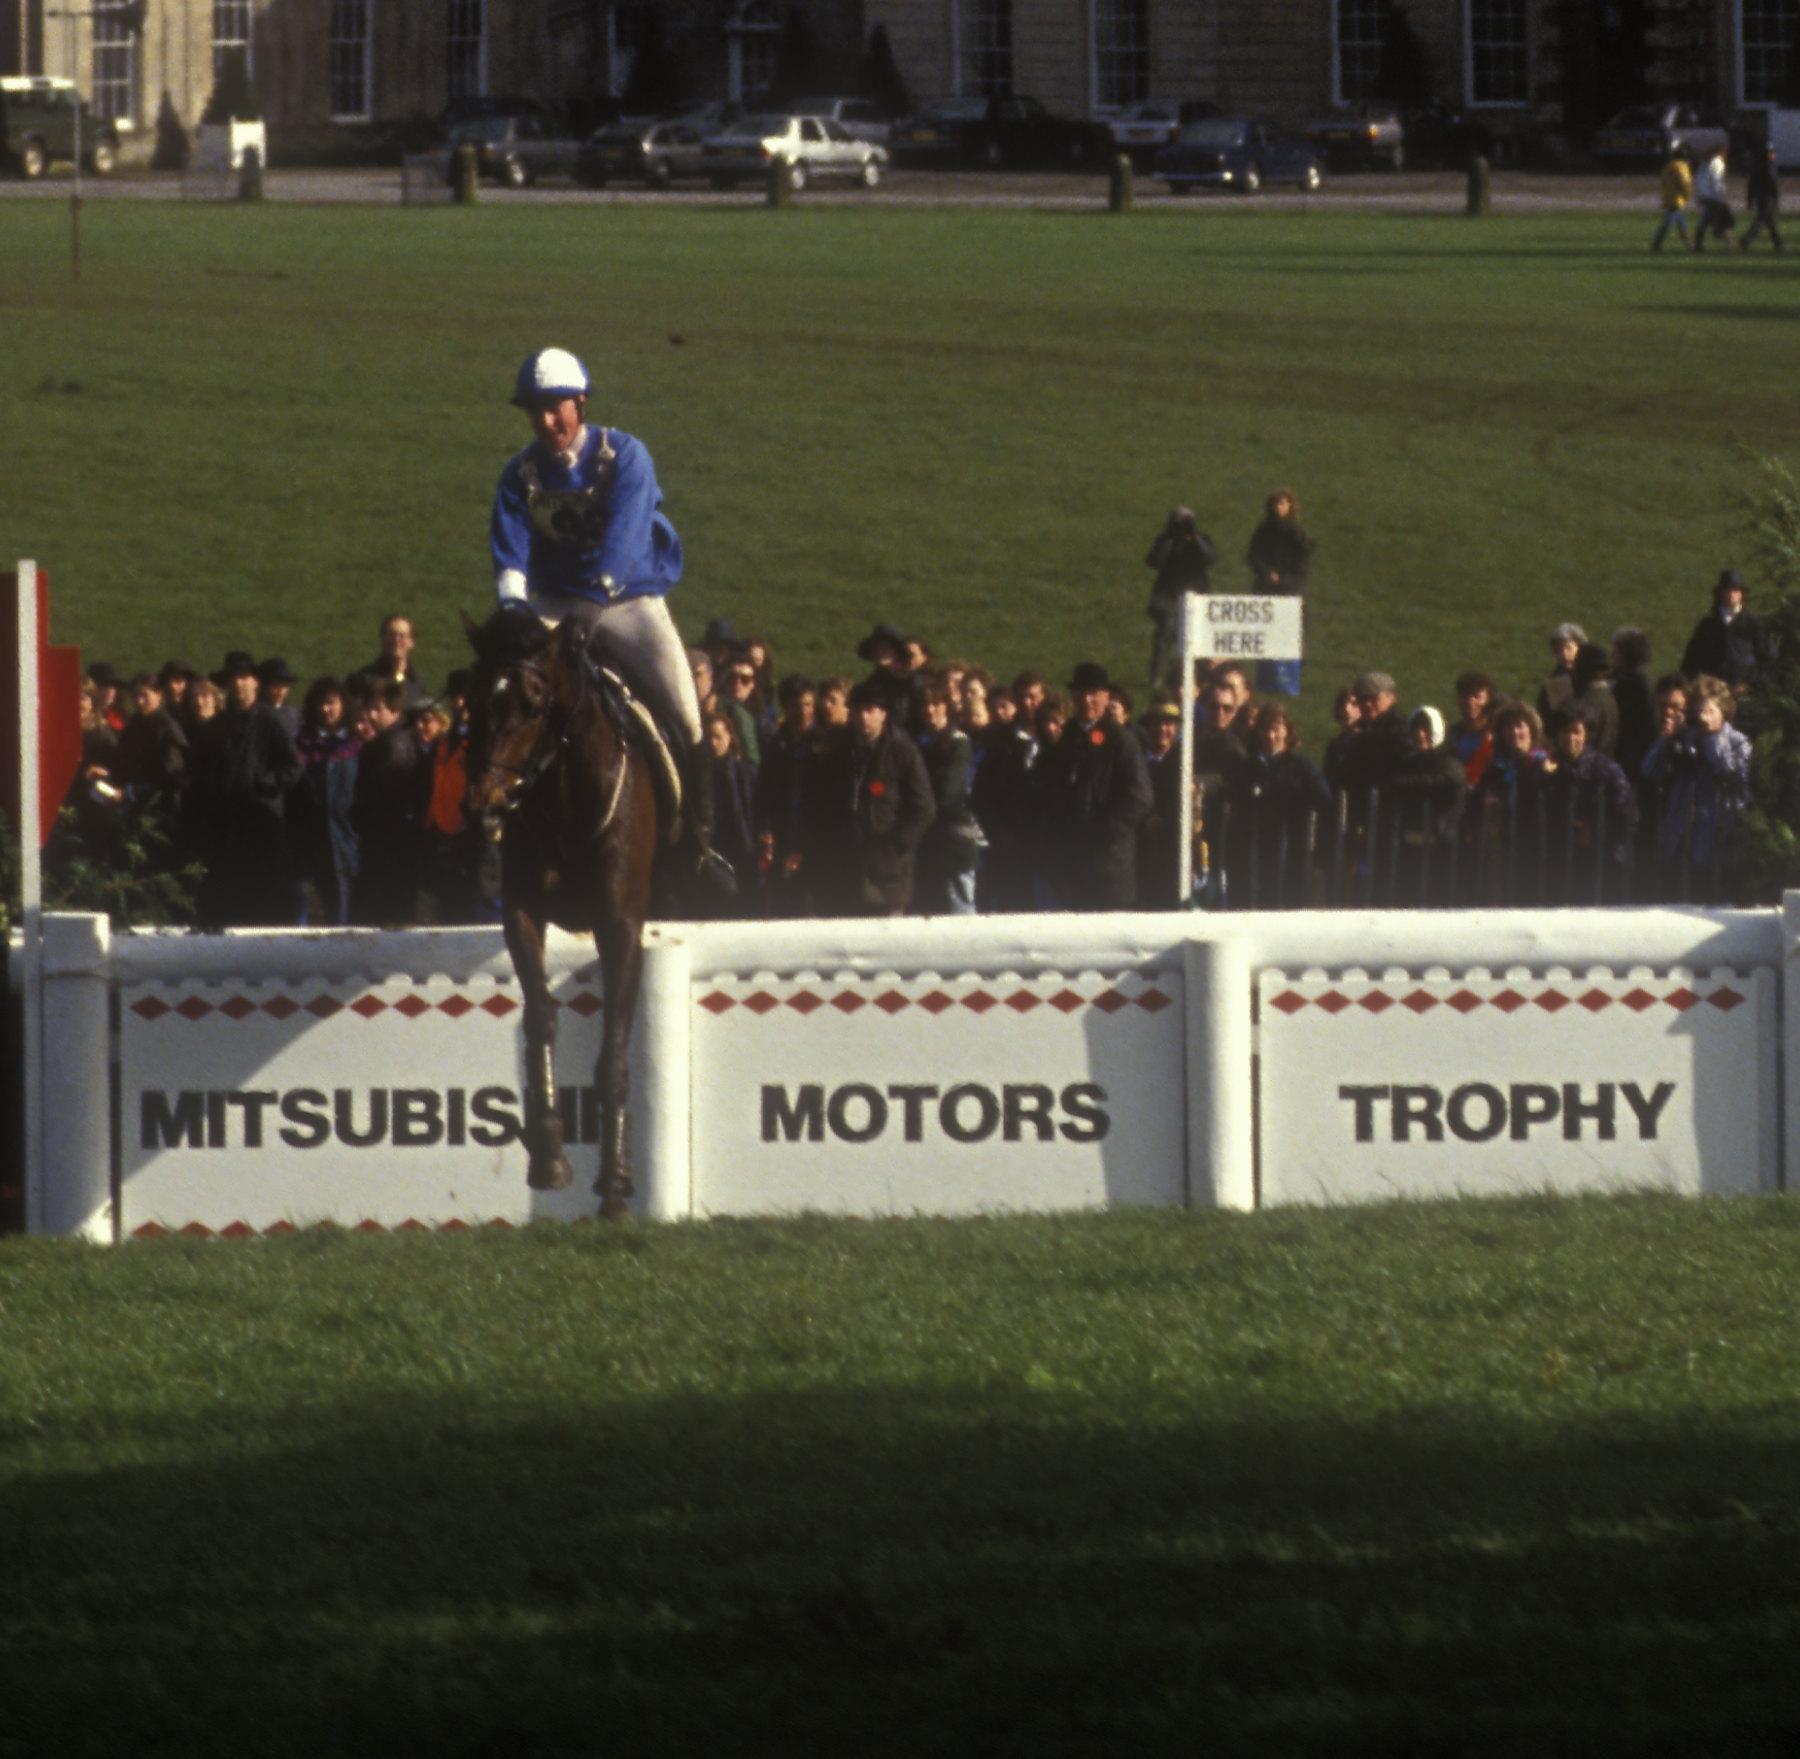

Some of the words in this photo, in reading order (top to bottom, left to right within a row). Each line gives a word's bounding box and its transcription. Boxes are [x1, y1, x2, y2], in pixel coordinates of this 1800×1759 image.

[1207, 600, 1274, 623] CROSS
[1213, 631, 1265, 654] HERE
[760, 1082, 1110, 1143] MOTORS
[1338, 1081, 1676, 1143] TROPHY
